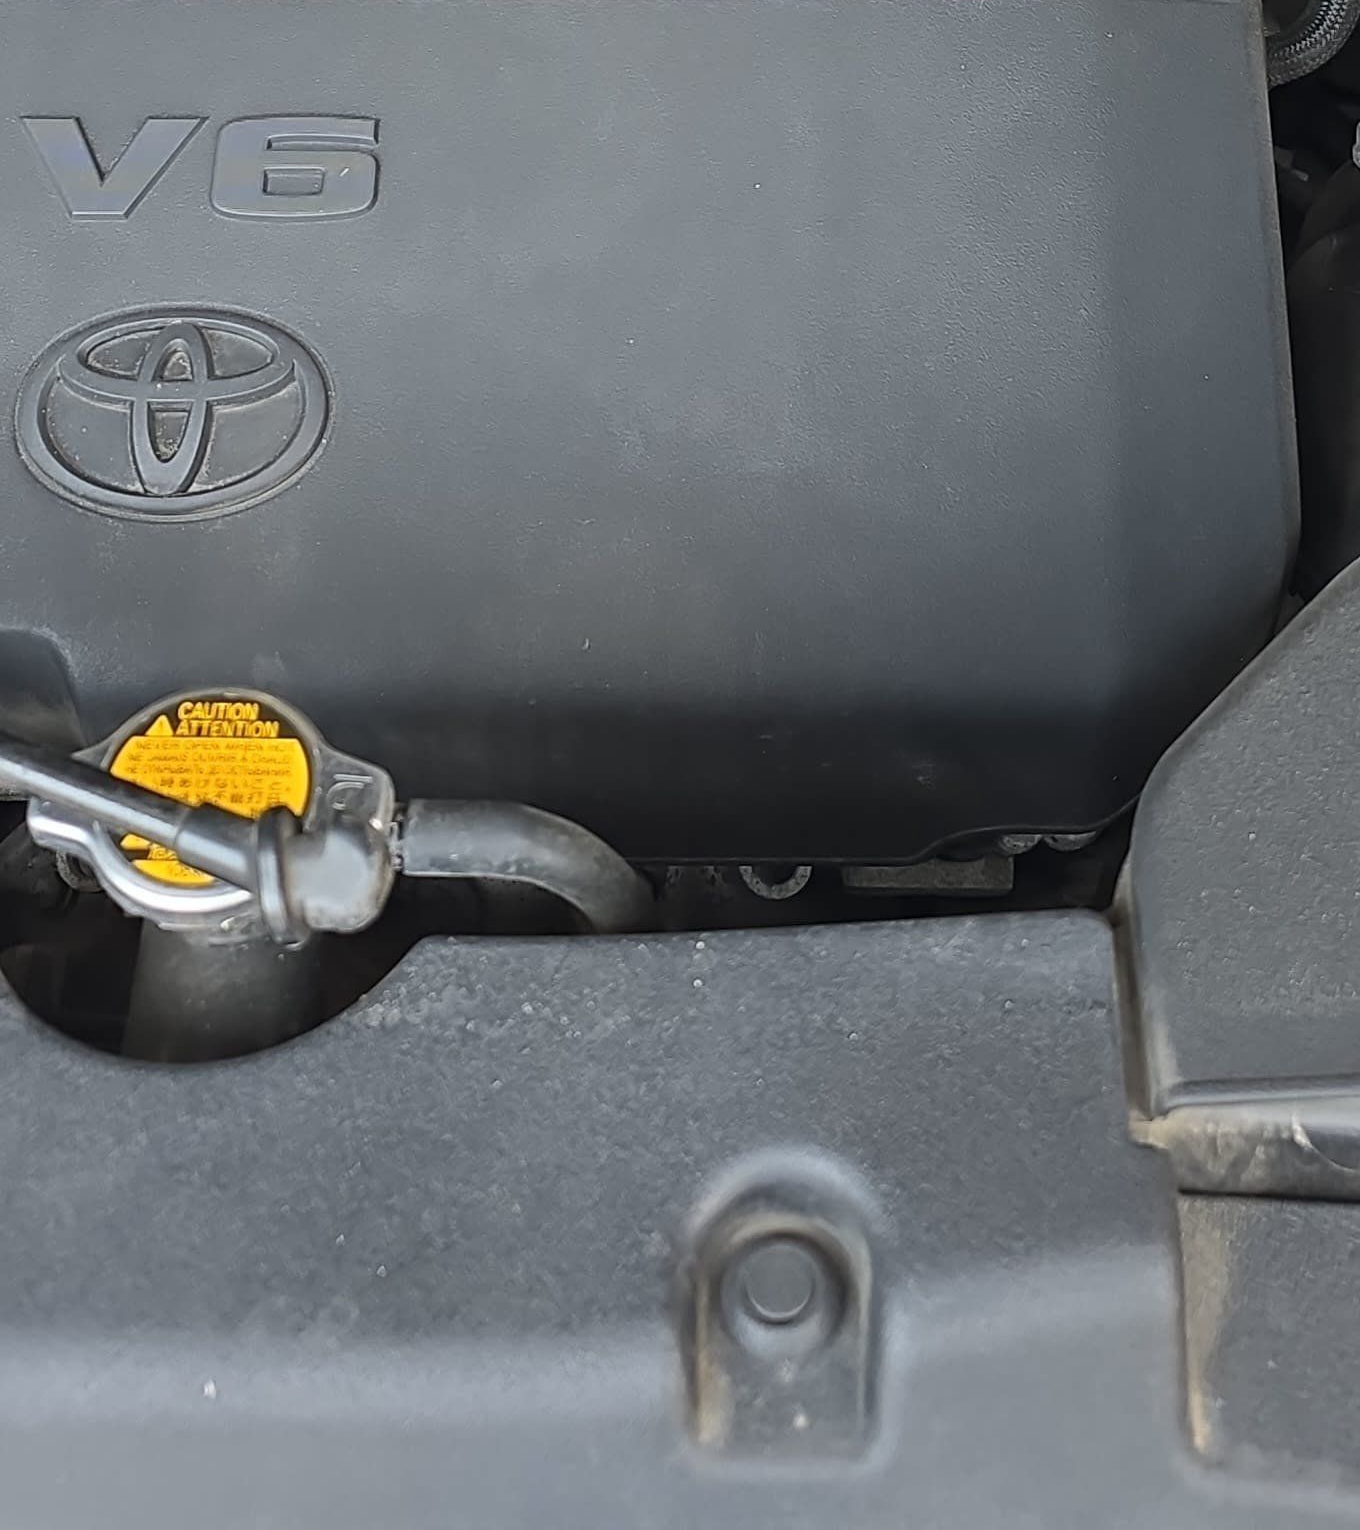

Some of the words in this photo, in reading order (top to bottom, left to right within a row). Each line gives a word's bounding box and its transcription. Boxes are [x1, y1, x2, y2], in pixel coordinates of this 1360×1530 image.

[20, 115, 381, 223] V6
[177, 701, 260, 720] CAUTION
[175, 720, 281, 738] ATTENTION
